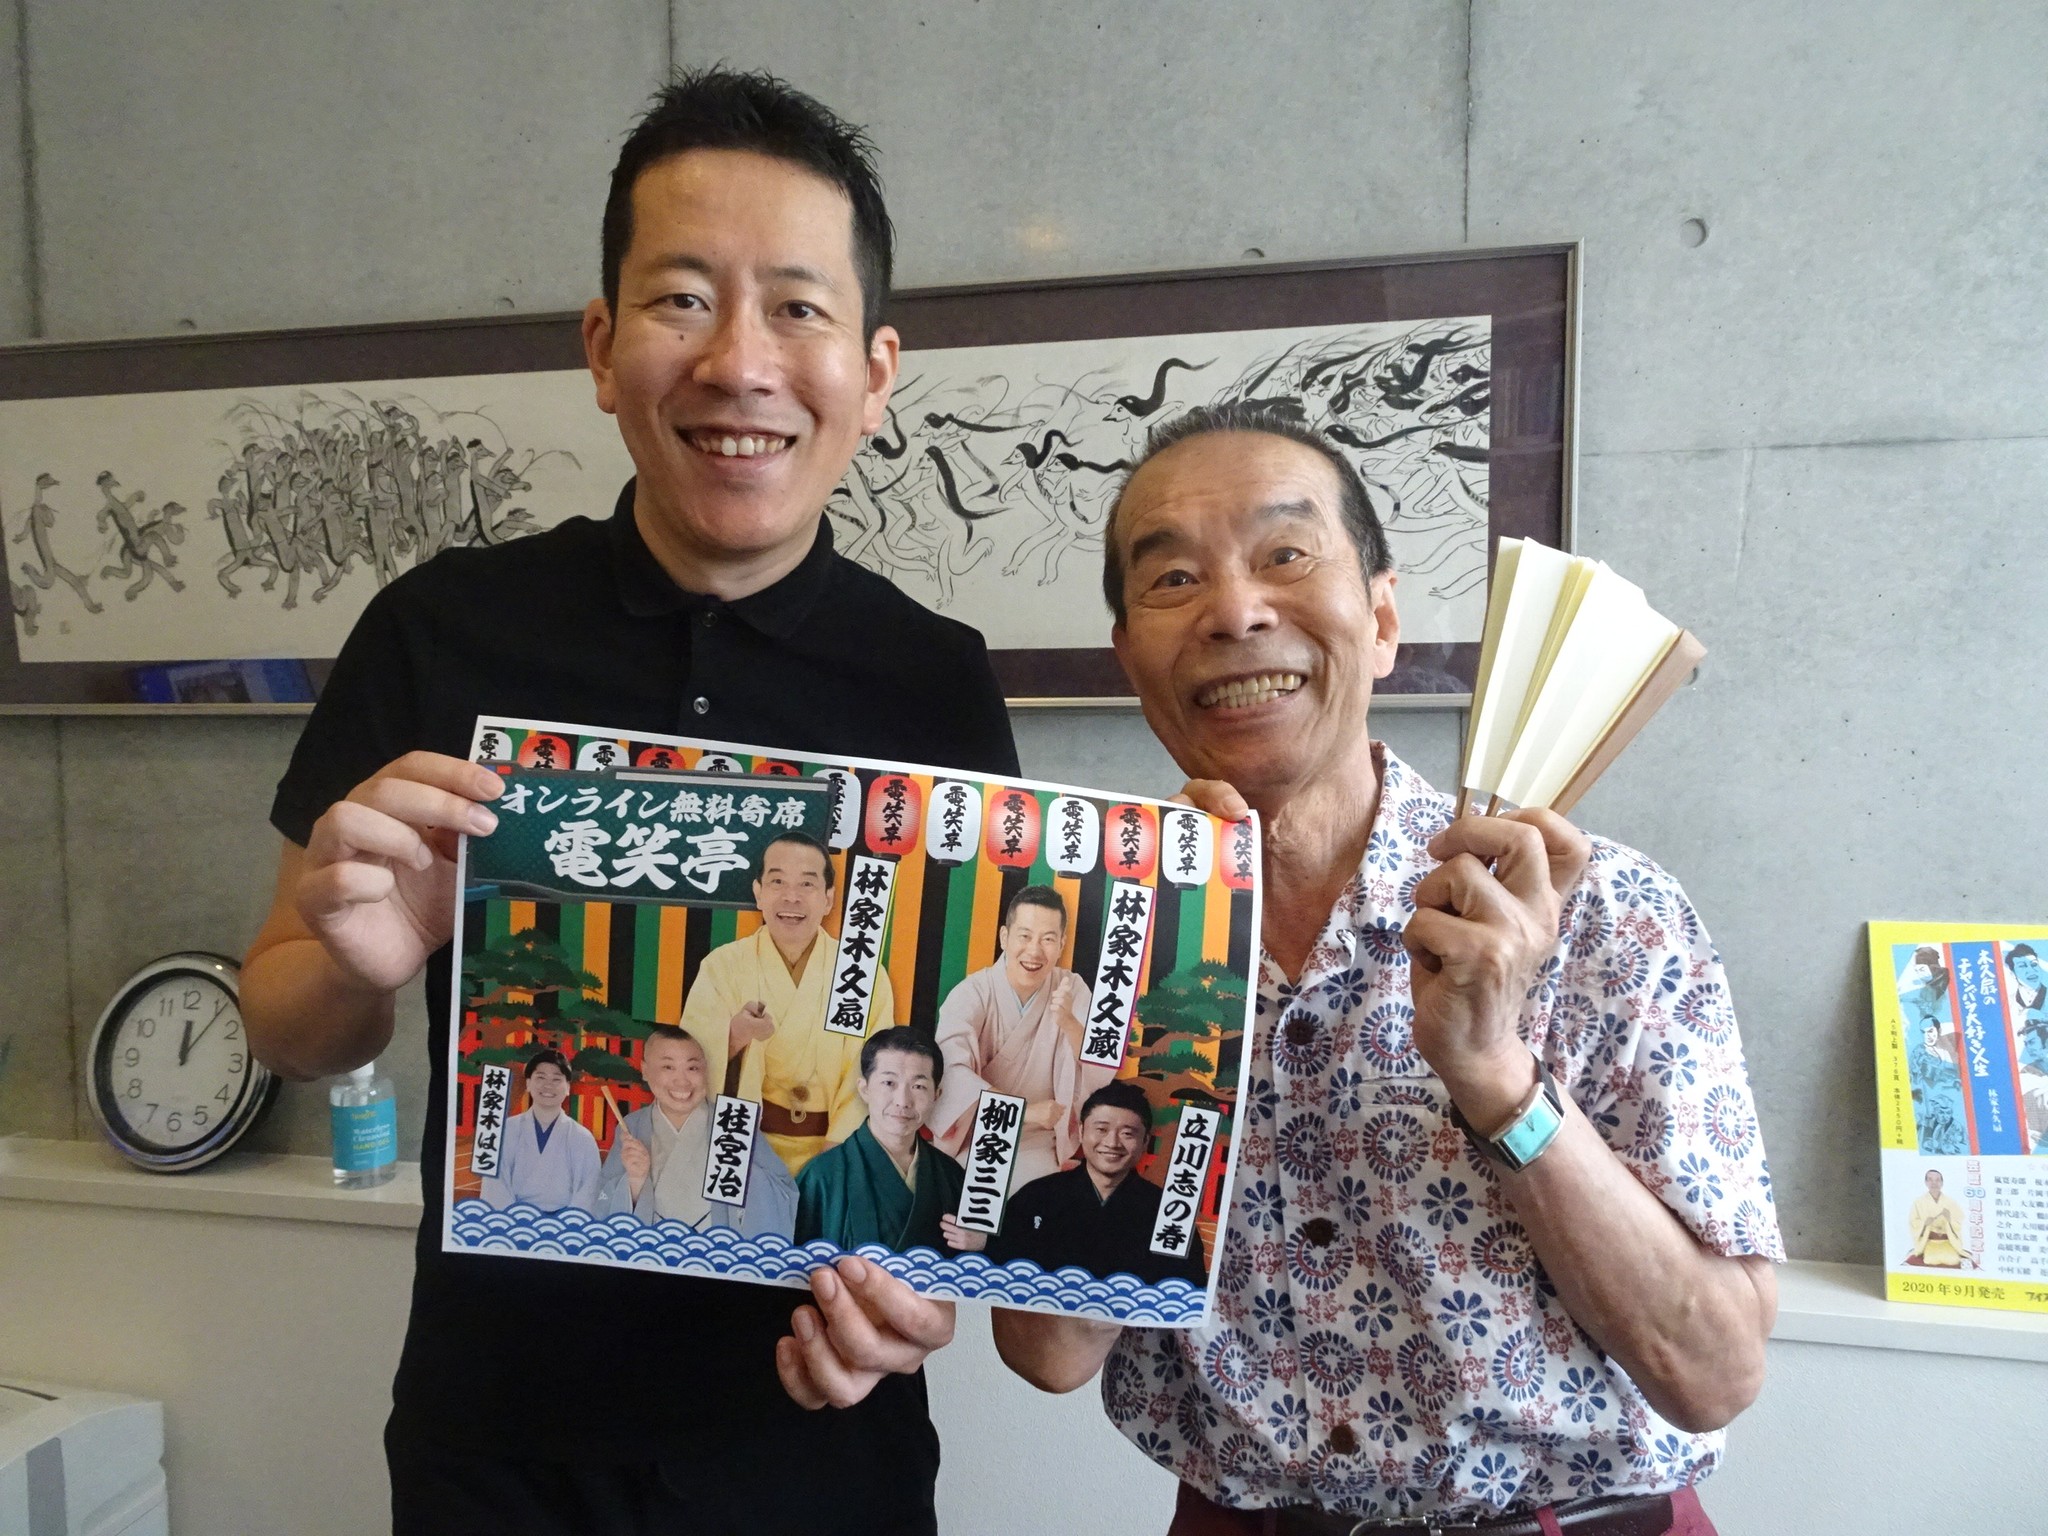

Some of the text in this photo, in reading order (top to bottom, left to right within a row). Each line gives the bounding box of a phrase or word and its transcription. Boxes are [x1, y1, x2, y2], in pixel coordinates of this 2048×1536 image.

[501, 783, 807, 829] オンライン無料寄席
[879, 778, 908, 846] 電笑亭
[939, 785, 969, 853] 電笑亭
[999, 794, 1027, 859] 電笑亭
[1059, 800, 1086, 864] 電笑亭
[544, 820, 750, 893] 電笑亭
[1119, 807, 1144, 870] 電笑亭
[1177, 813, 1200, 875] 電笑亭
[829, 863, 889, 1031] 林家木久扇
[1084, 889, 1148, 1060] 林家木久蔵
[136, 1018, 156, 1038] 10
[159, 997, 174, 1016] 11
[183, 990, 202, 1010] 12
[223, 1019, 240, 1040] 2
[124, 1047, 140, 1068] 9
[127, 1078, 143, 1099] 8
[227, 1052, 244, 1074] 3
[146, 1103, 160, 1123] 7
[166, 1111, 182, 1133] 6
[192, 1105, 208, 1126] 5
[214, 1083, 231, 1105] 4
[474, 1069, 508, 1171] 林家木はち
[706, 1102, 752, 1198] 桂宮治
[960, 1097, 1020, 1229] 柳家三三
[1155, 1113, 1212, 1251] 立川志の春
